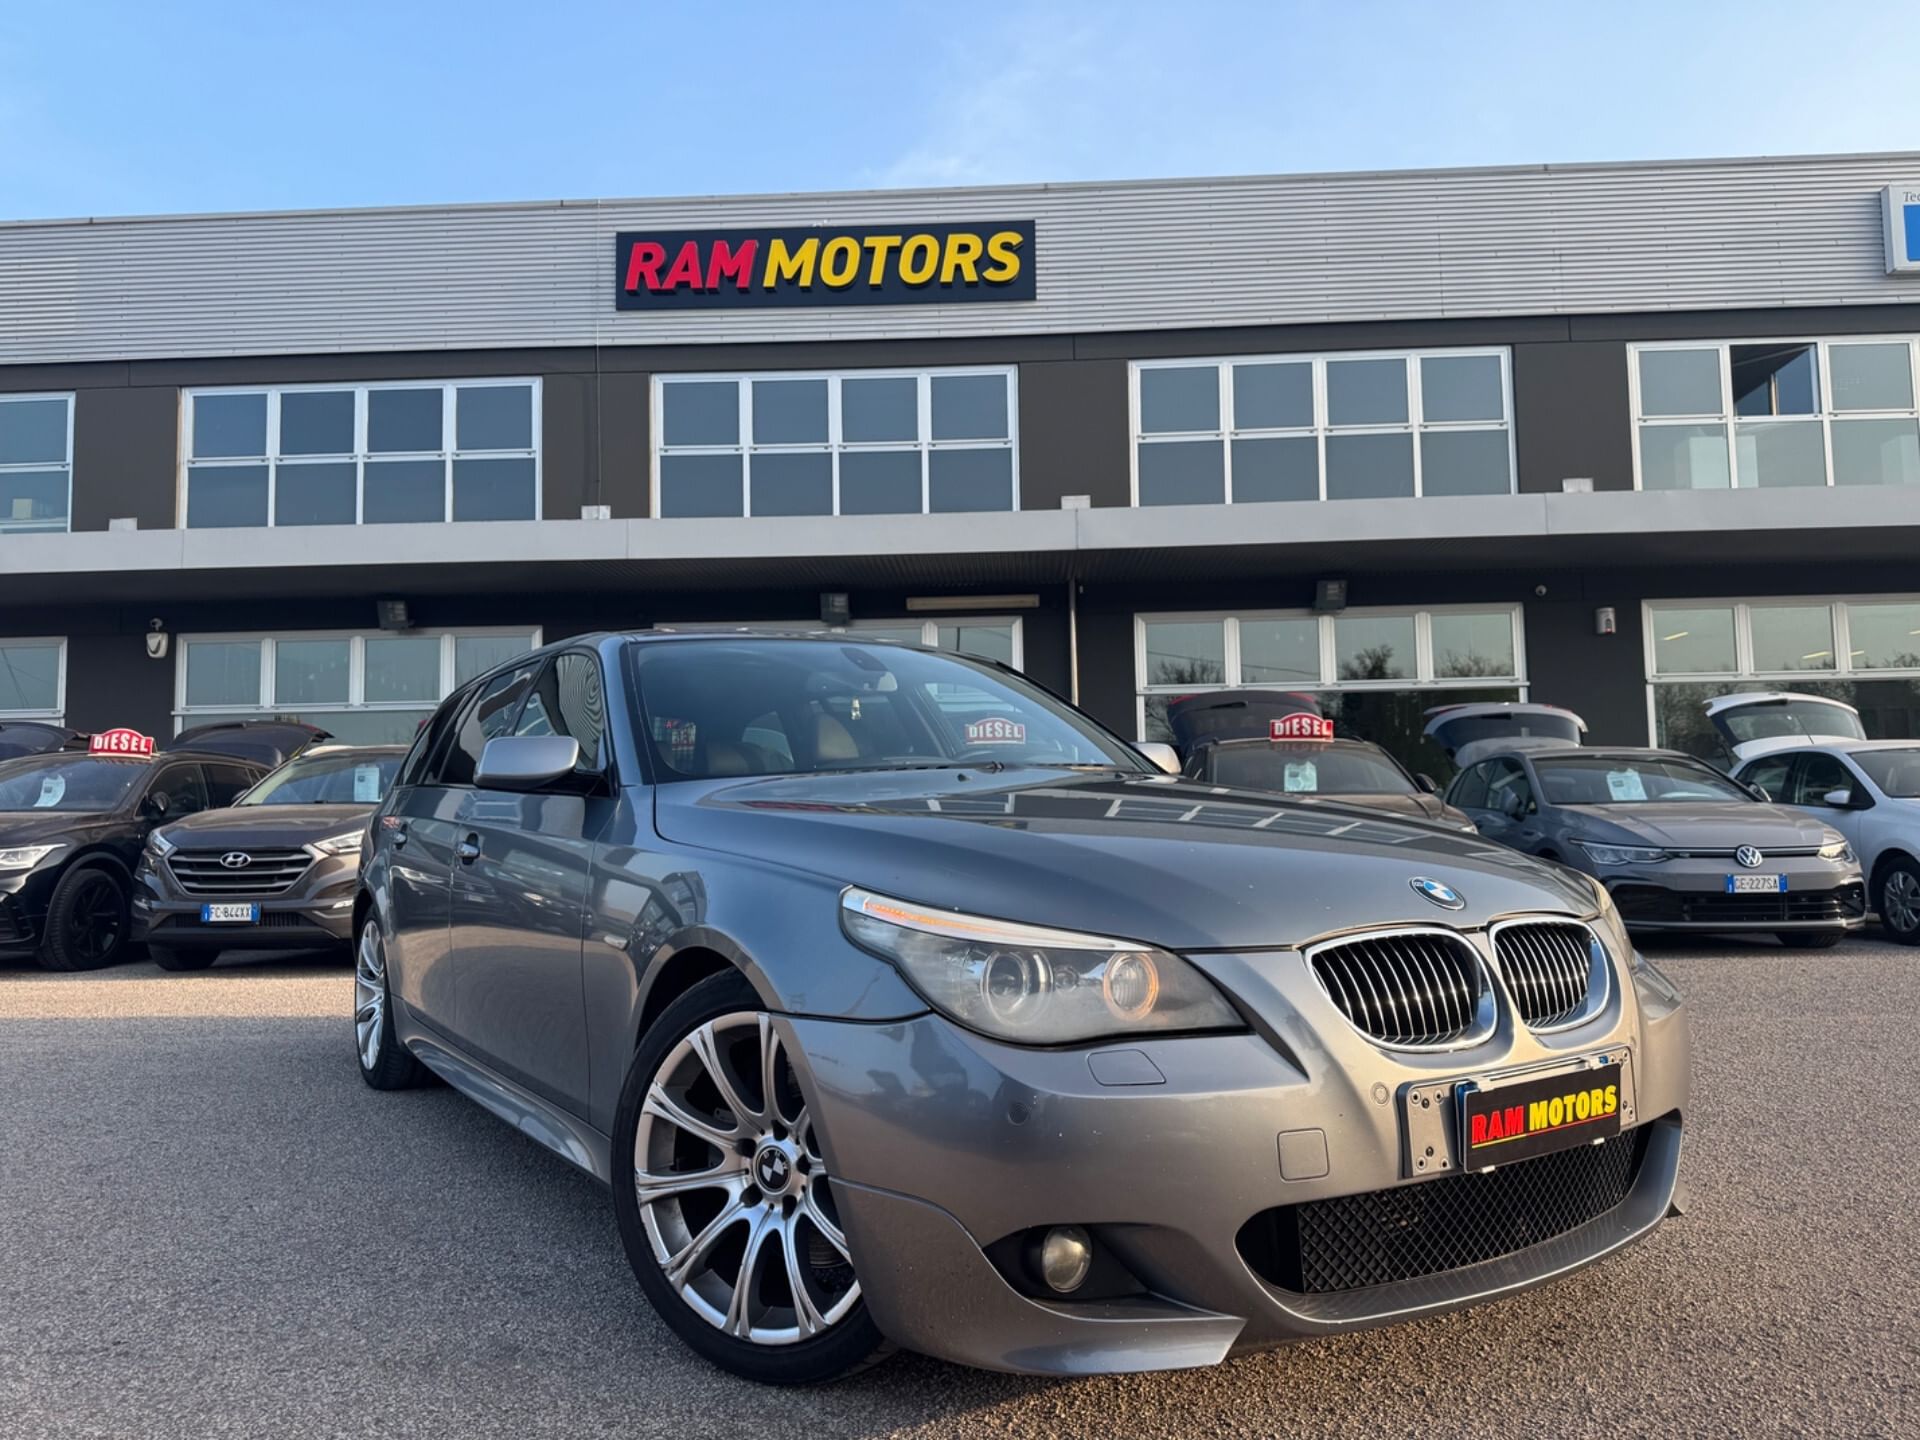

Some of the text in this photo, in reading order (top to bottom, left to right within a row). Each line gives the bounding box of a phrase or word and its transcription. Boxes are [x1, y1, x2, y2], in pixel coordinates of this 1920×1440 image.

[624, 231, 1024, 292] RAM MOTORS
[966, 721, 1022, 739] DIESEL
[1274, 717, 1330, 736] DIESEL
[93, 733, 148, 752] DIESEL
[1471, 1085, 1617, 1144] RAM MOTORS
